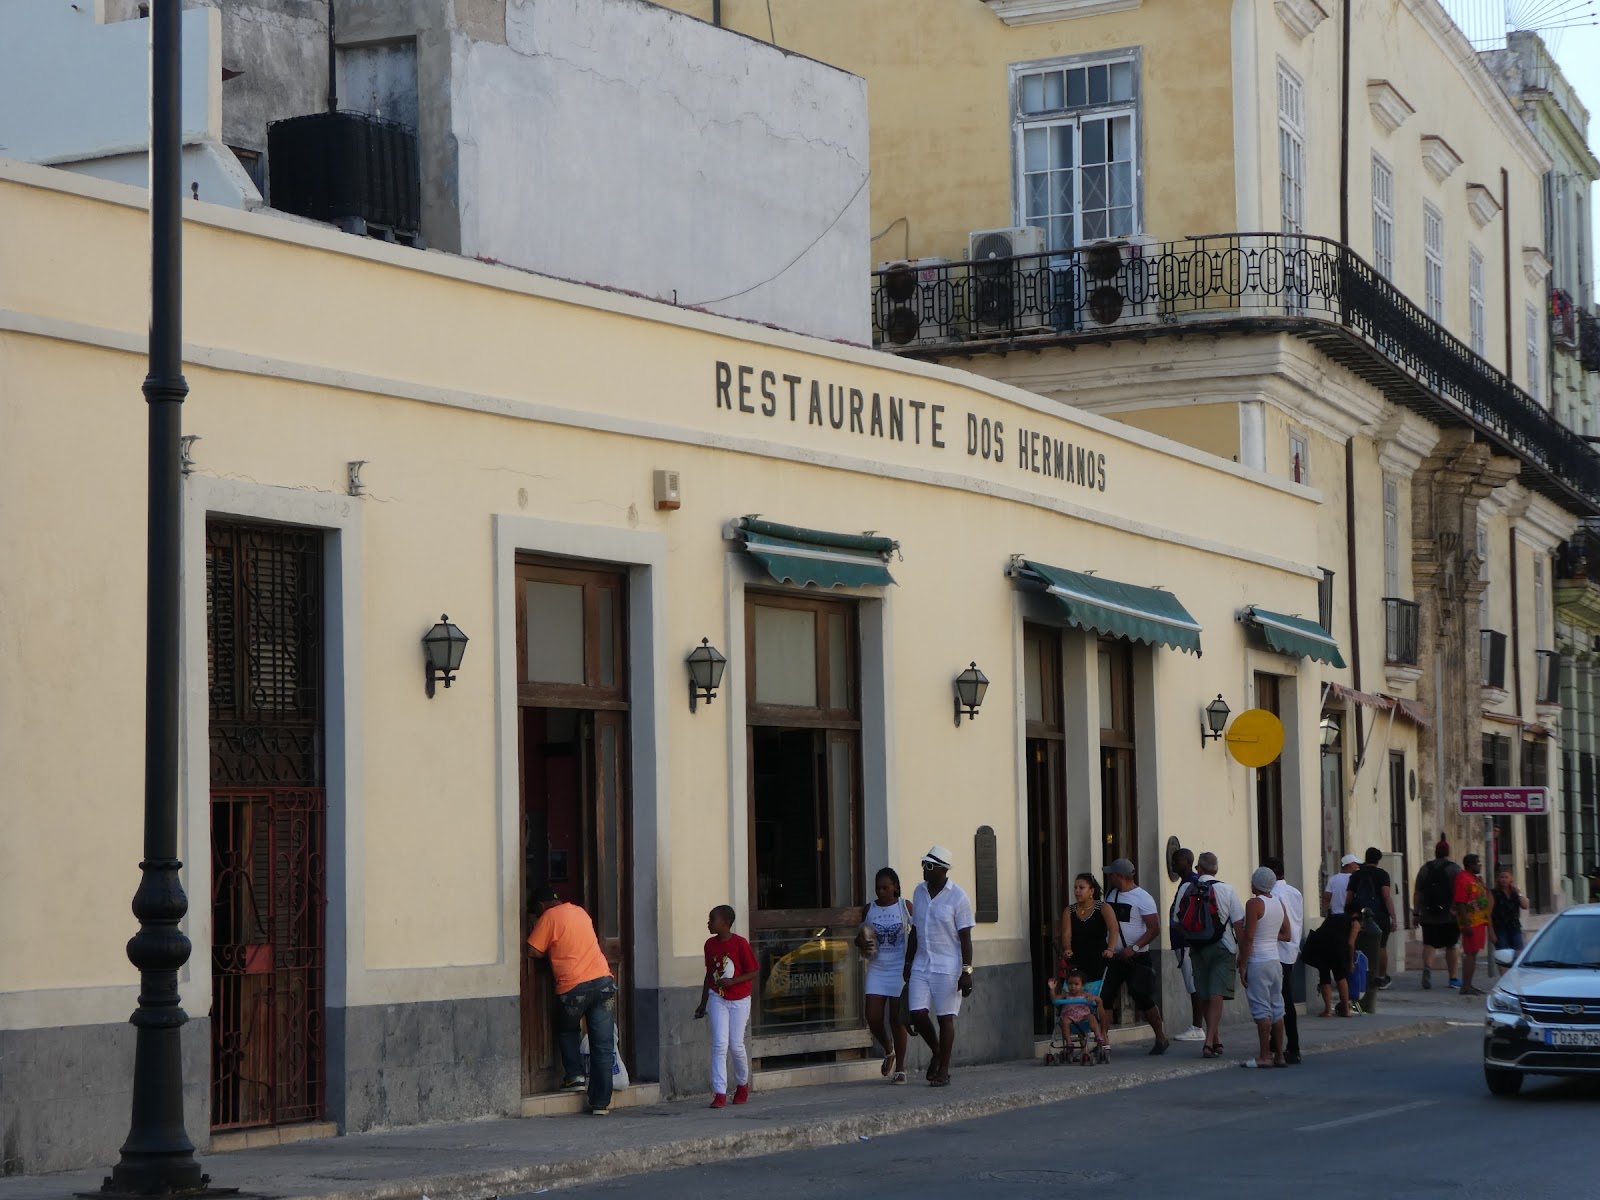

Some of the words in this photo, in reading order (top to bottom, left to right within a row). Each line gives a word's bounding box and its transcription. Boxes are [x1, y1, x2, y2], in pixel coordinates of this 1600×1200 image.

[715, 360, 946, 449] RESTAURANTE
[967, 412, 1004, 463] DOS
[1018, 428, 1107, 492] HERMANOS
[789, 971, 834, 989] HERMANOS
